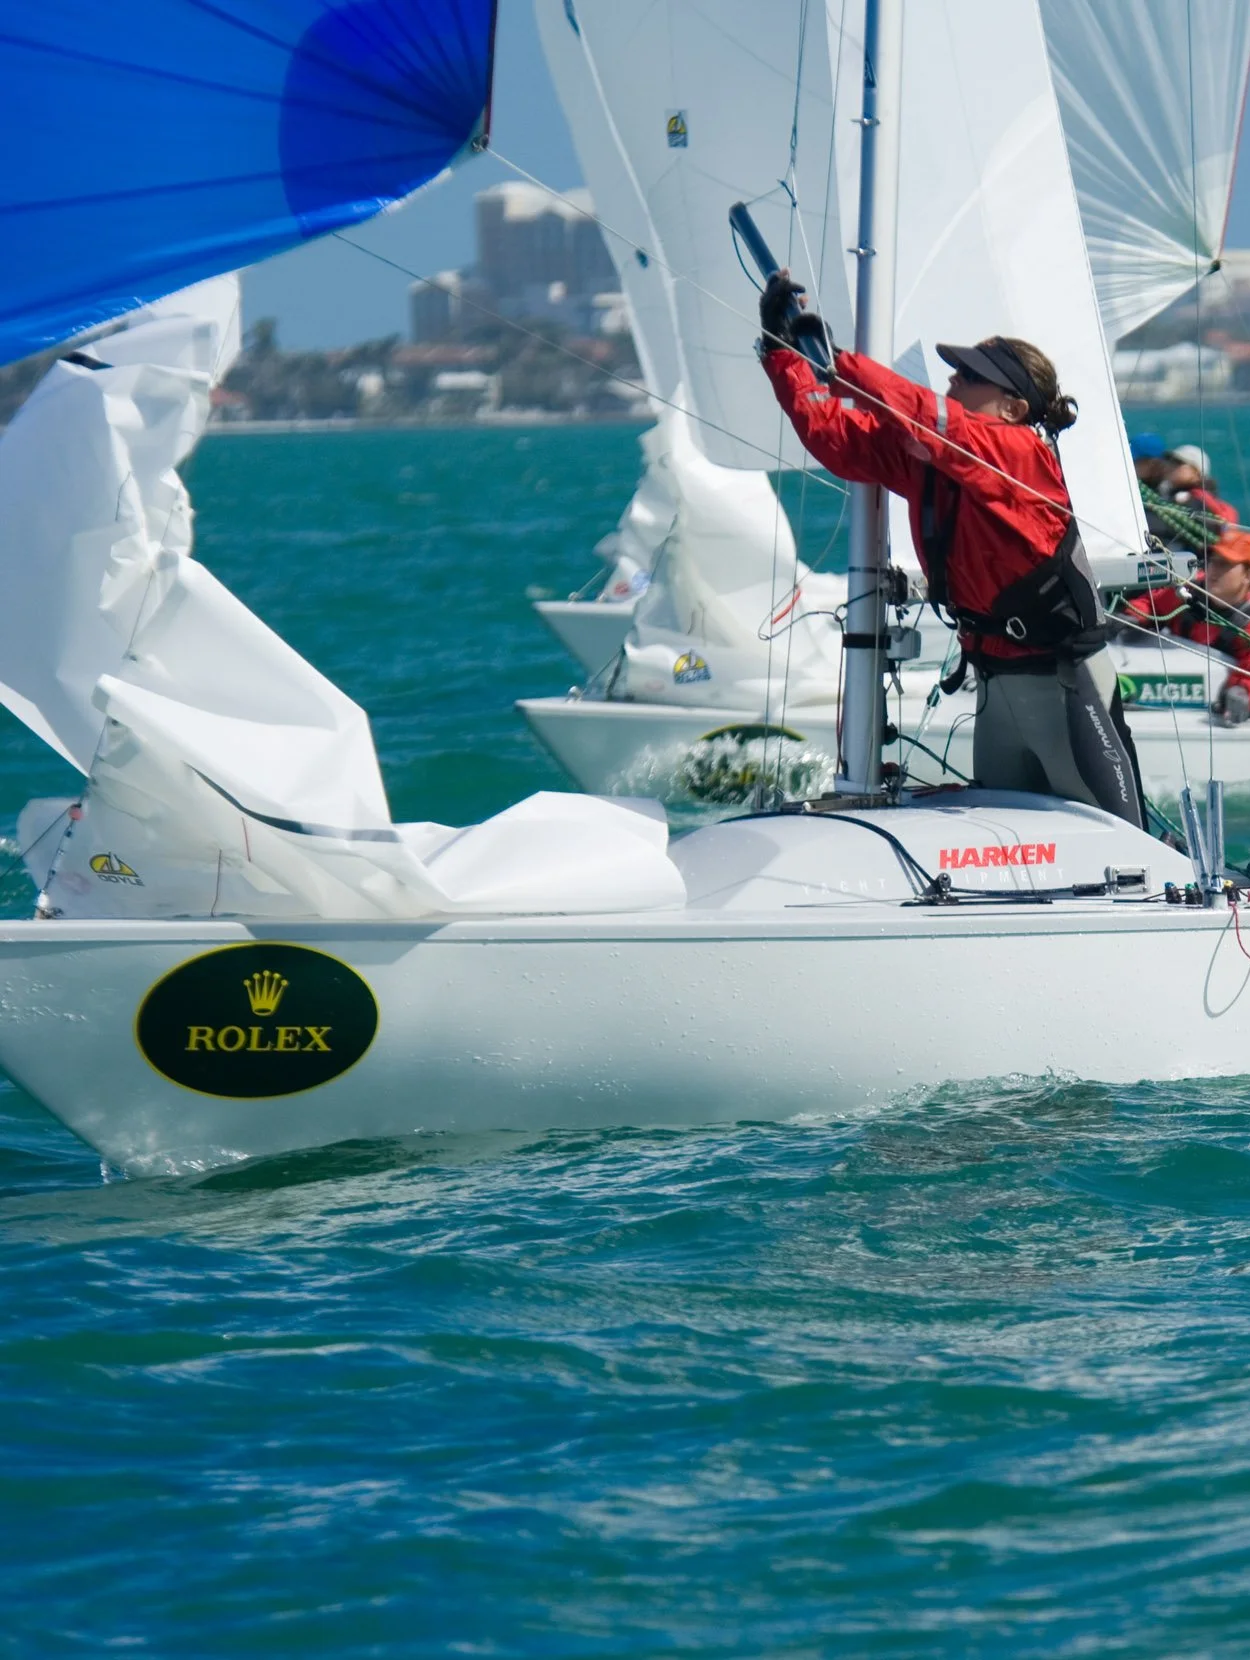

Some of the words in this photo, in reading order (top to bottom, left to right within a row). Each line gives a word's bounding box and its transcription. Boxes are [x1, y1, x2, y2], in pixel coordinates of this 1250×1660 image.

[1139, 682, 1204, 701] AIGLE
[938, 843, 1056, 870] HARKEN
[184, 1025, 333, 1052] ROLEX
